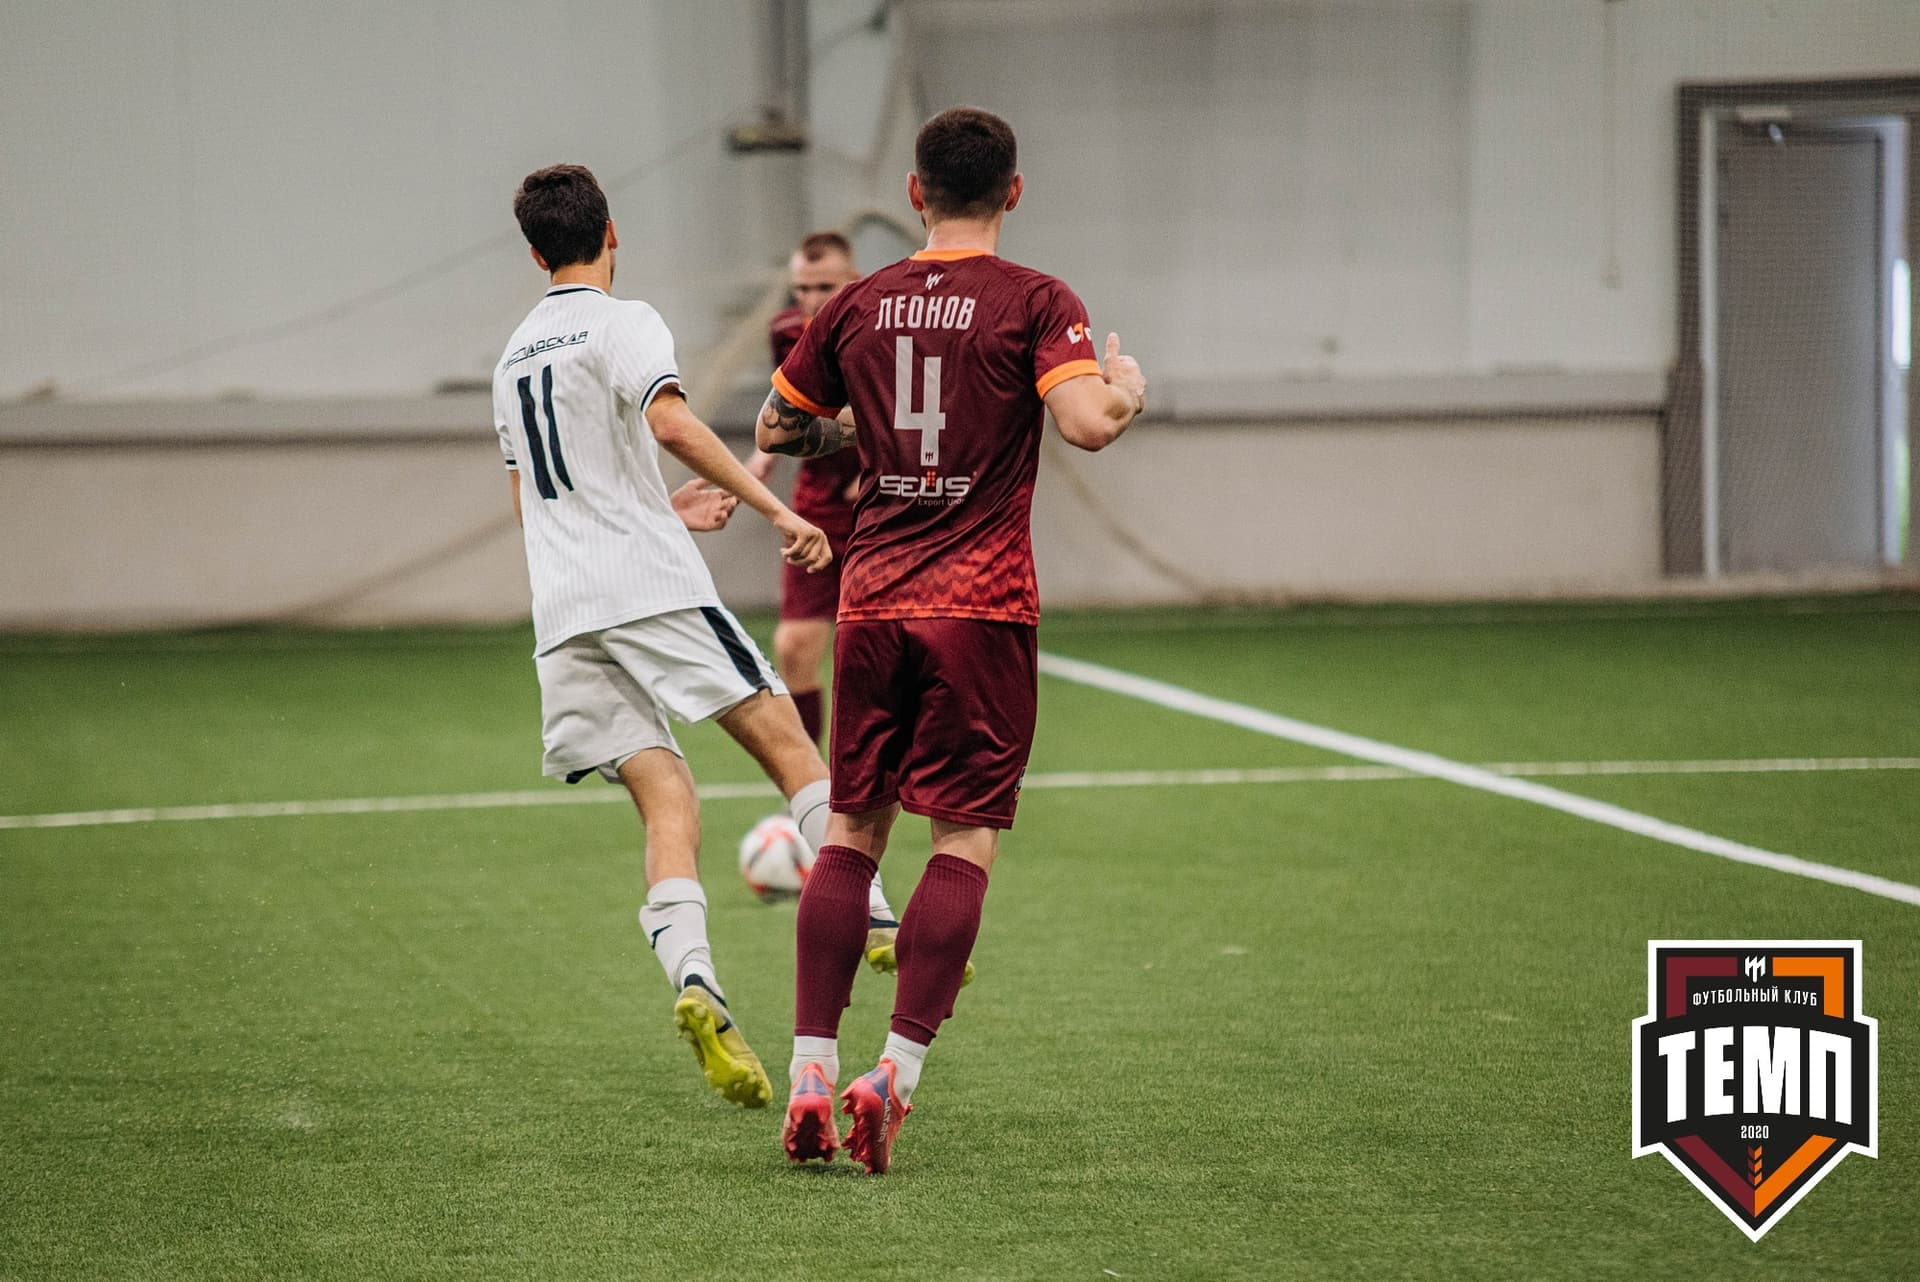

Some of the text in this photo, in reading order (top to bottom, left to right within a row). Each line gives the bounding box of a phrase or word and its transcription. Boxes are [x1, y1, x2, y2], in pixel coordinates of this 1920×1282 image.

[875, 295, 976, 330] ЛЕОНОВ
[517, 364, 574, 499] 11
[894, 335, 946, 466] 4
